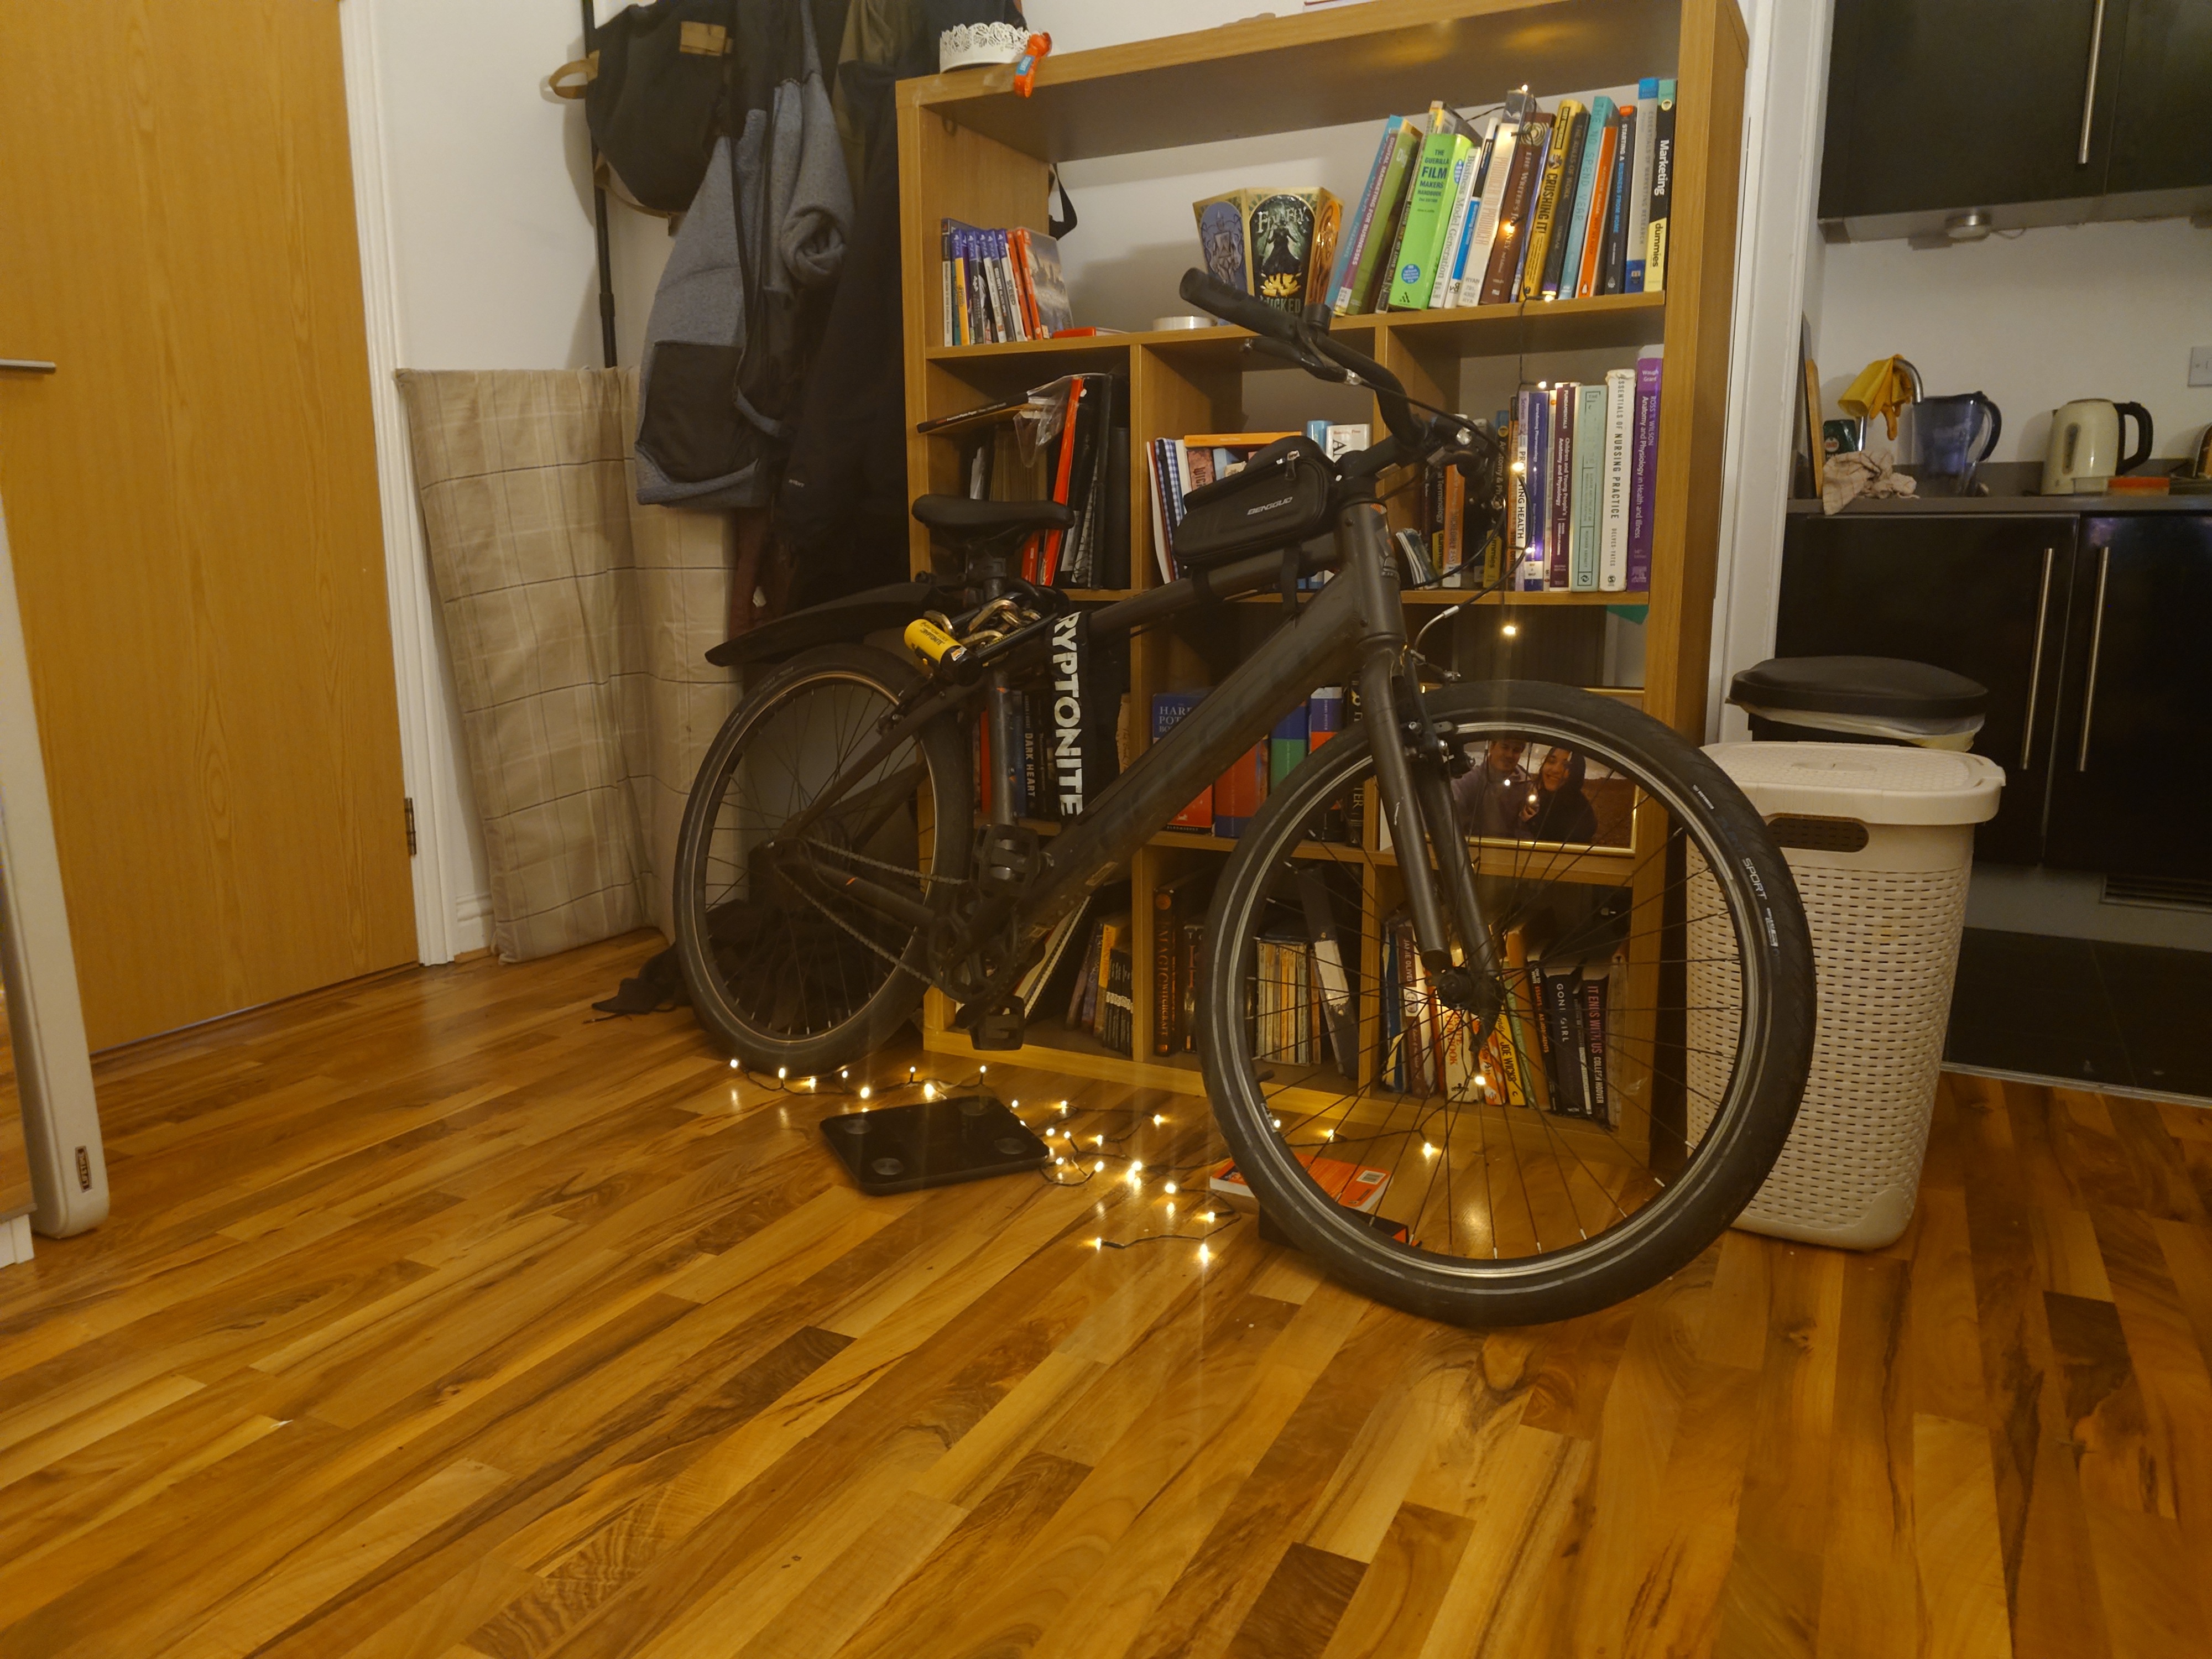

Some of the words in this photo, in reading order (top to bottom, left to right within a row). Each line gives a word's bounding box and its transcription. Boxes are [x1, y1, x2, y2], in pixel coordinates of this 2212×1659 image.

[1592, 101, 1604, 123] THE
[1383, 138, 1395, 164] DIGITAL
[1588, 130, 1598, 144] NO
[1422, 166, 1447, 179] FILM
[1522, 151, 1532, 169] THE
[1580, 151, 1595, 186] SPEND
[1653, 139, 1670, 196] Marketing
[1369, 165, 1386, 207] MARKETING
[1420, 180, 1443, 189] MAKERS
[1458, 154, 1475, 195] Business
[1562, 176, 1573, 199] WORK
[1512, 171, 1528, 211] WRITER'S
[1540, 173, 1558, 221] CRUSHING
[1364, 208, 1374, 223] FOR
[1451, 196, 1465, 226] Model
[1574, 193, 1587, 221] YEAR
[1475, 207, 1496, 245] PRODUCER
[1502, 212, 1519, 251] JONEY
[1535, 221, 1548, 234] IT!
[1352, 223, 1368, 265] BUSINESSES
[1390, 251, 1399, 268] SHUT
[1395, 241, 1401, 250] UP
[1437, 227, 1457, 278] Generation
[1650, 223, 1663, 267] dummies
[1616, 376, 1625, 418] ESSENTIALS
[1639, 395, 1650, 425] Anatomy
[1647, 420, 1655, 446] WILSON
[1494, 441, 1508, 476] Antomy
[1612, 434, 1623, 472] NURSING
[1634, 440, 1646, 475] Physiology
[1193, 467, 1206, 487] WIC
[1517, 451, 1526, 503] PRTING
[1434, 479, 1446, 523] Terminology
[1610, 477, 1620, 519] PRACTICE
[1635, 484, 1644, 504] Health
[1516, 507, 1525, 539] HEALTH
[1634, 519, 1642, 538] Illness
[1489, 539, 1498, 568] mmies
[1053, 611, 1083, 816] RYPTONITE
[1159, 716, 1181, 725] POT
[1160, 706, 1192, 715] HAR
[1024, 732, 1034, 759] DARK
[1026, 763, 1036, 797] HEART
[1742, 856, 1767, 903] SPORT
[1157, 929, 1168, 983] MAGIC
[1533, 985, 1542, 1006] ESSAYS
[1587, 985, 1598, 994] IT
[1588, 995, 1600, 1017] ENS
[1559, 1018, 1569, 1042] GIRL
[1500, 1040, 1512, 1057] JOE
[1591, 1042, 1602, 1053] US
[1503, 1057, 1517, 1082] WICKS
[1594, 1081, 1604, 1104] HOOVER
